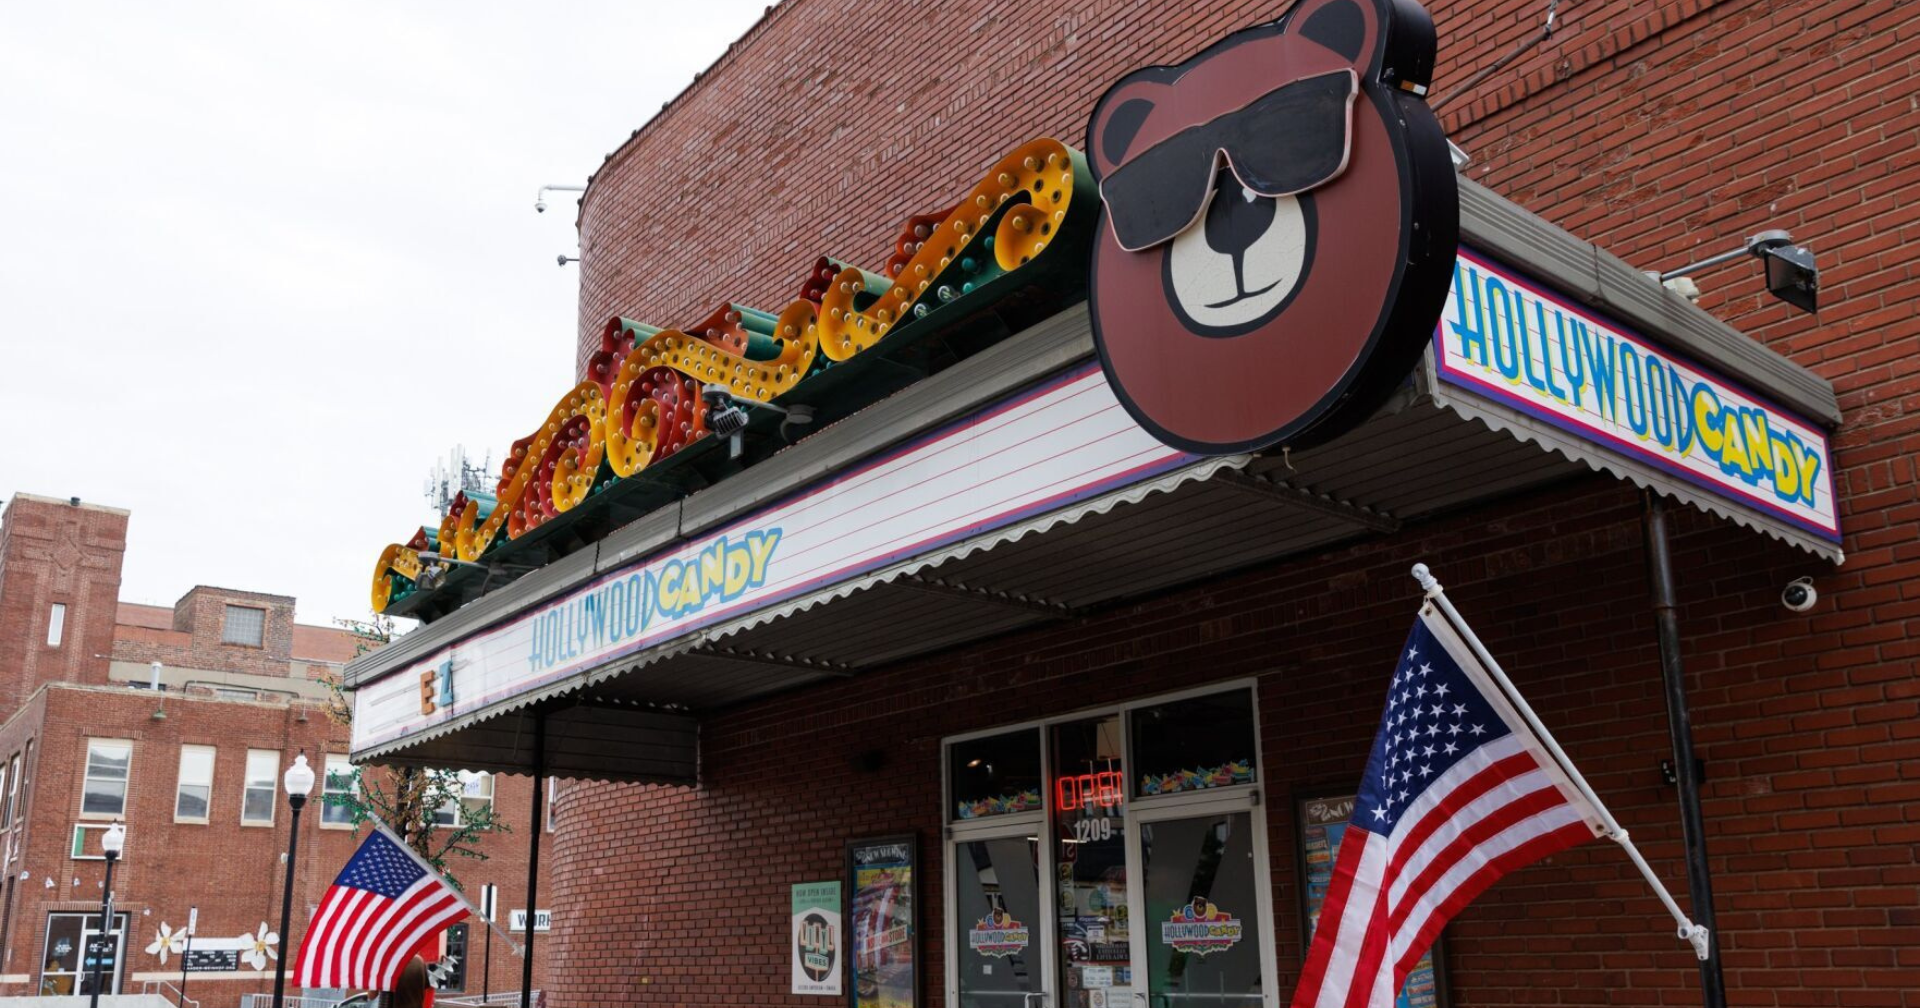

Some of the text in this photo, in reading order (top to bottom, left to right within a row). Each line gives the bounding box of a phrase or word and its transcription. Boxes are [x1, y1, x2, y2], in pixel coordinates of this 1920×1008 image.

[1450, 261, 1821, 508] HOLLYWOOD CANDY
[528, 528, 783, 673] HOLLYWOOD CANDY
[1074, 818, 1111, 841] 1209
[1164, 924, 1209, 938] HOLLYWOOD
[807, 955, 827, 967] VIBES
